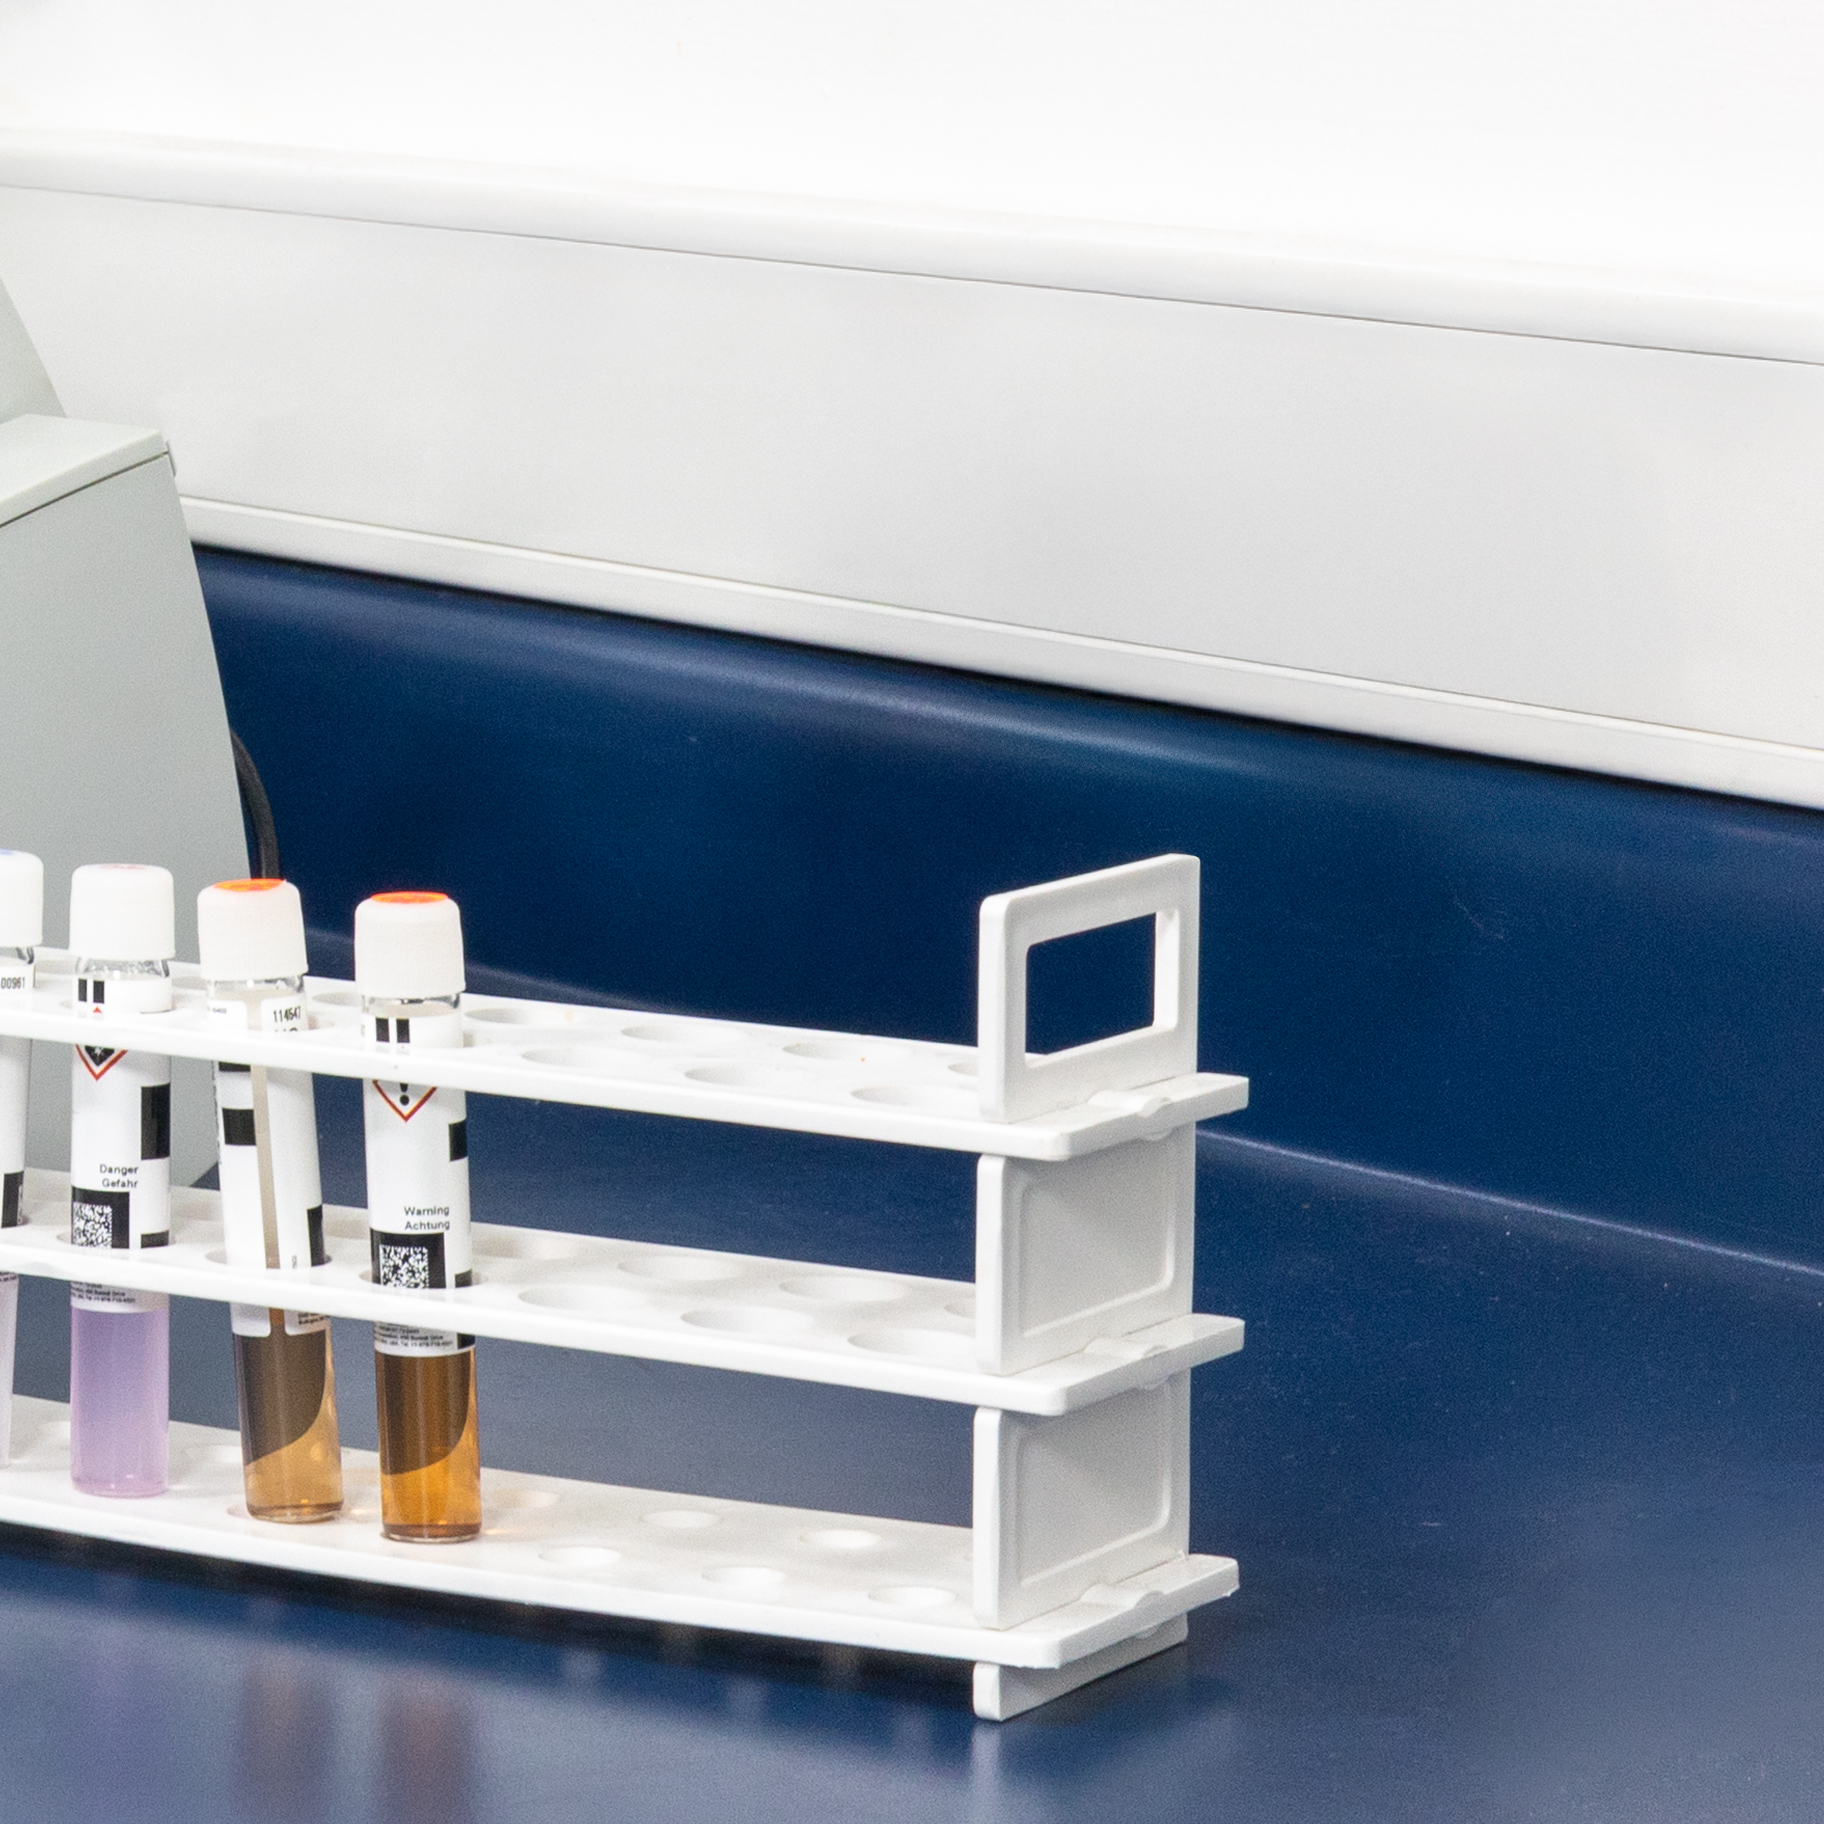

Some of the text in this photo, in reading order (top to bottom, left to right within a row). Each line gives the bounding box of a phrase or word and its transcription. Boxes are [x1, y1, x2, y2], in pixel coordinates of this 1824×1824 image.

[99, 1163, 140, 1177] Danger
[101, 1177, 140, 1189] Gefahr
[403, 1205, 451, 1218] Warning
[404, 1220, 452, 1232] Achtung
